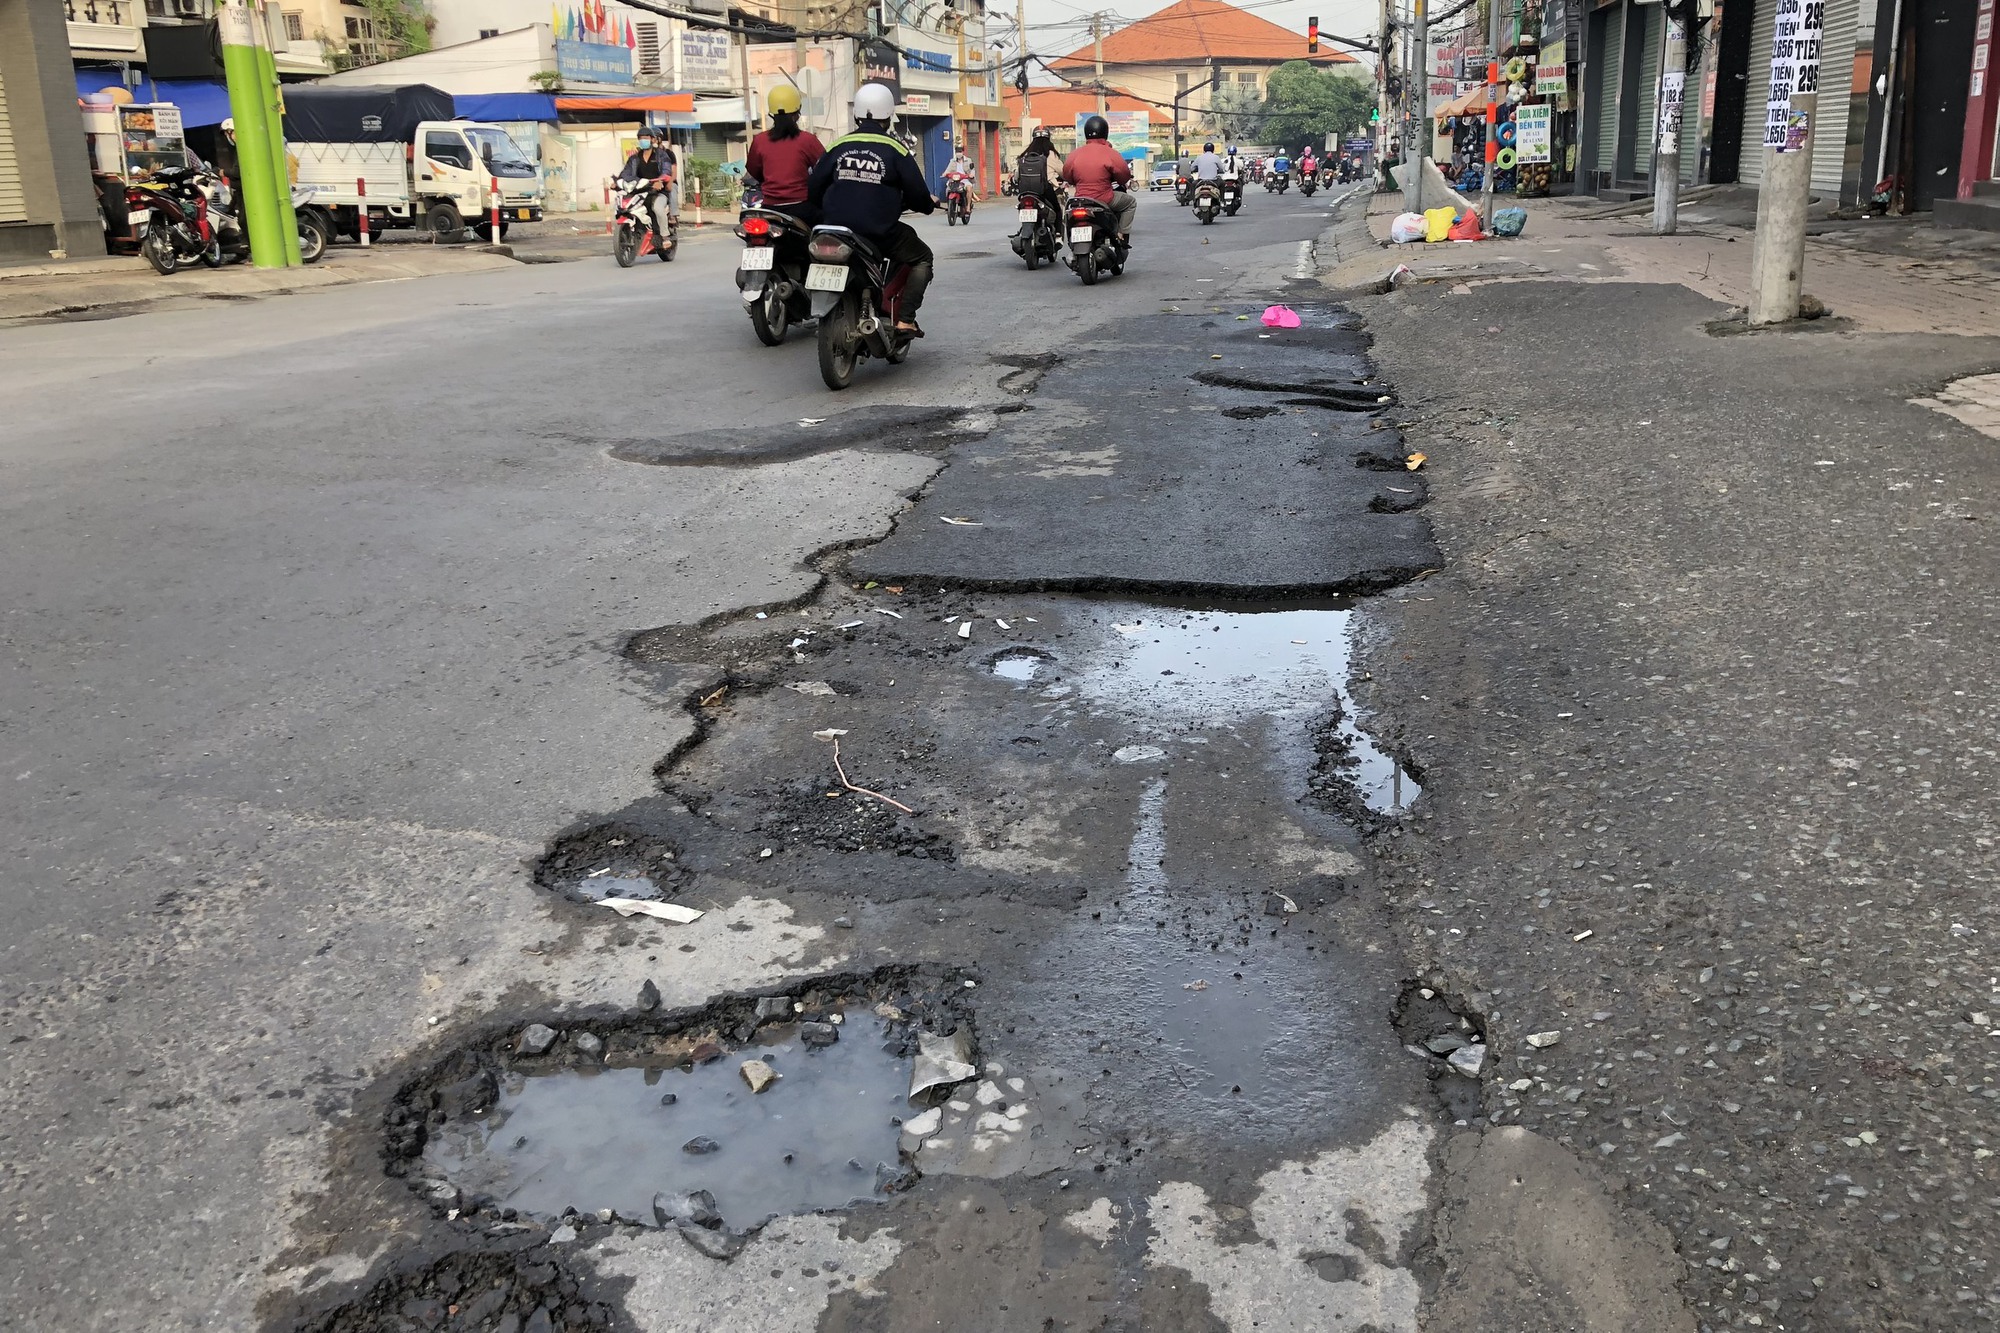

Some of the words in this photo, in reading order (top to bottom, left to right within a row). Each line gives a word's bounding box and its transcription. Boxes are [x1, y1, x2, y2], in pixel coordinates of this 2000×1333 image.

[1798, 64, 1820, 92] 295
[1534, 121, 1546, 129] TRE
[844, 156, 879, 171] TVN
